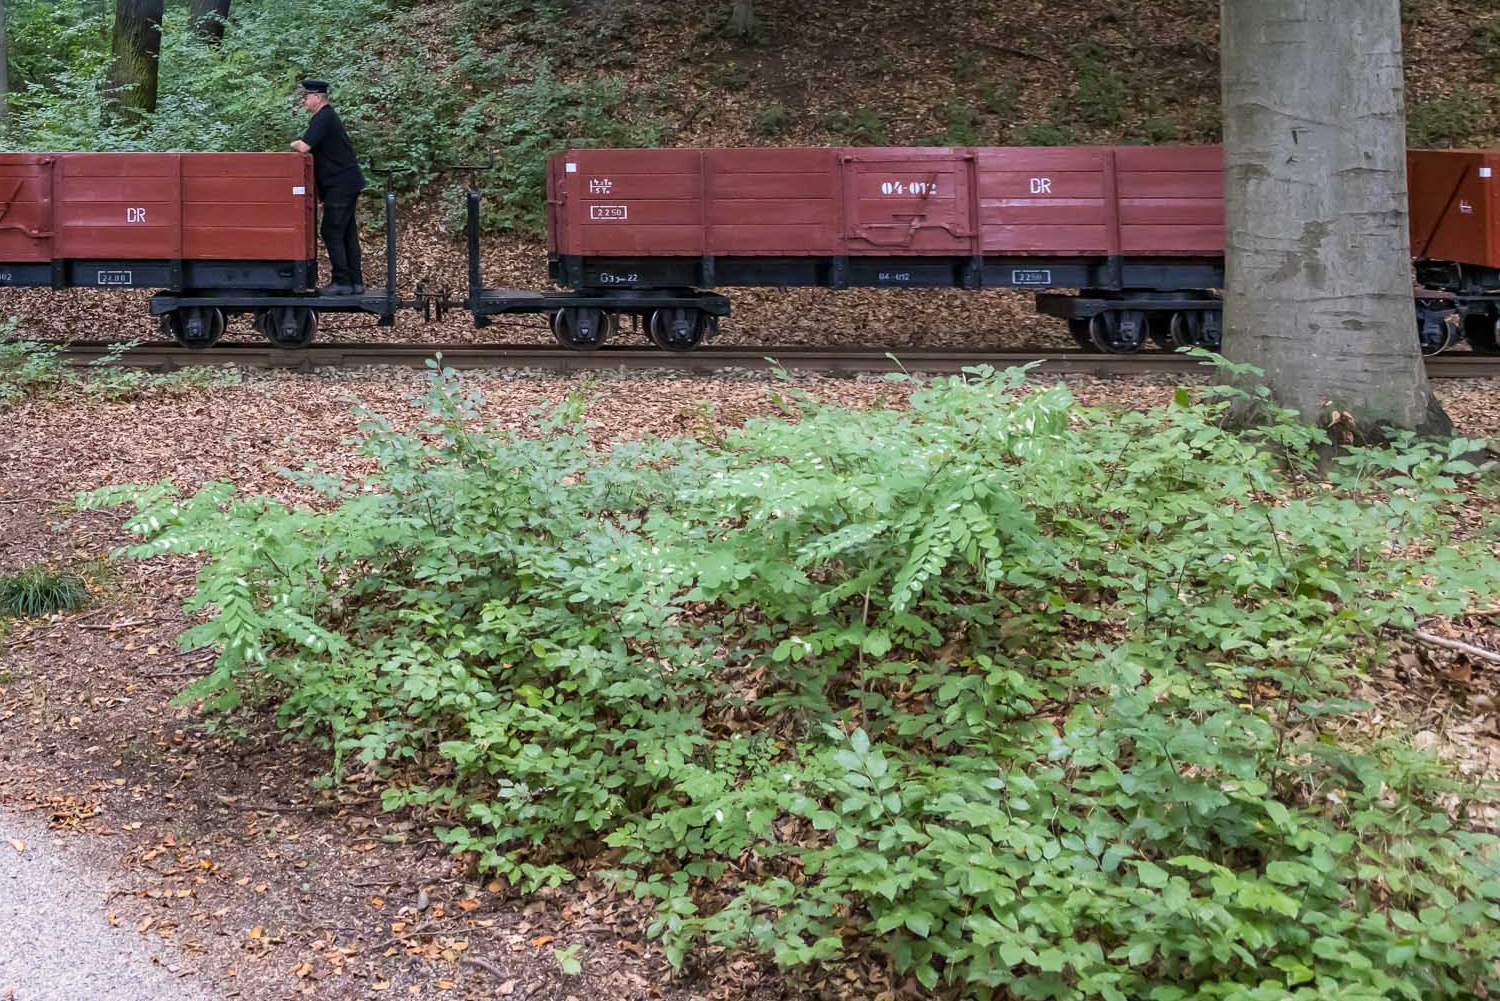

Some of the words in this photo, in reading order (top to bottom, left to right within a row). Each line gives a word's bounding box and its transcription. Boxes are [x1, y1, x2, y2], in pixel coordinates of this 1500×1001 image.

[881, 182, 937, 195] 04-012
[1029, 178, 1052, 194] DR
[127, 207, 146, 223] DR
[597, 208, 622, 217] 2250
